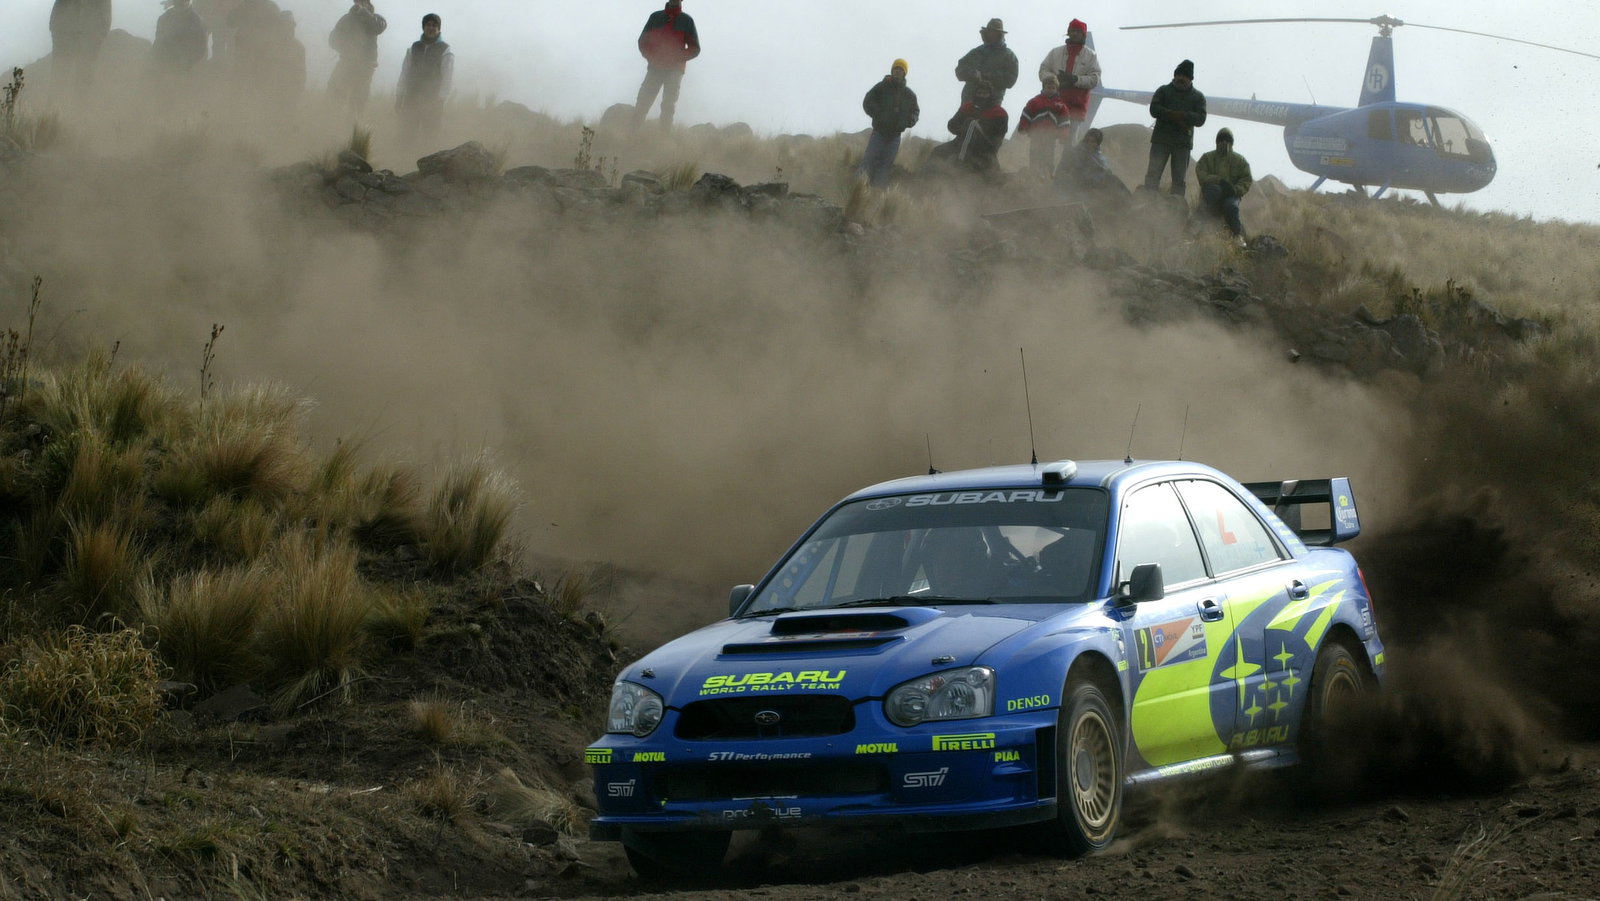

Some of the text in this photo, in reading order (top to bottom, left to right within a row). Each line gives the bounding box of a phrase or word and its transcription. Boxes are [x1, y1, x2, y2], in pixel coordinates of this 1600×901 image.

[905, 491, 1065, 507] SUBARU
[1140, 629, 1151, 669] 2
[703, 670, 846, 689] SUBARU
[699, 682, 841, 696] WORLD RALLY TEAM
[1007, 694, 1050, 711] DENSO
[855, 743, 899, 754] MOTUL
[932, 732, 995, 751] PIRELLI
[633, 752, 666, 762] MOTUL
[708, 752, 812, 761] STI Performance
[994, 750, 1020, 762] PIAA
